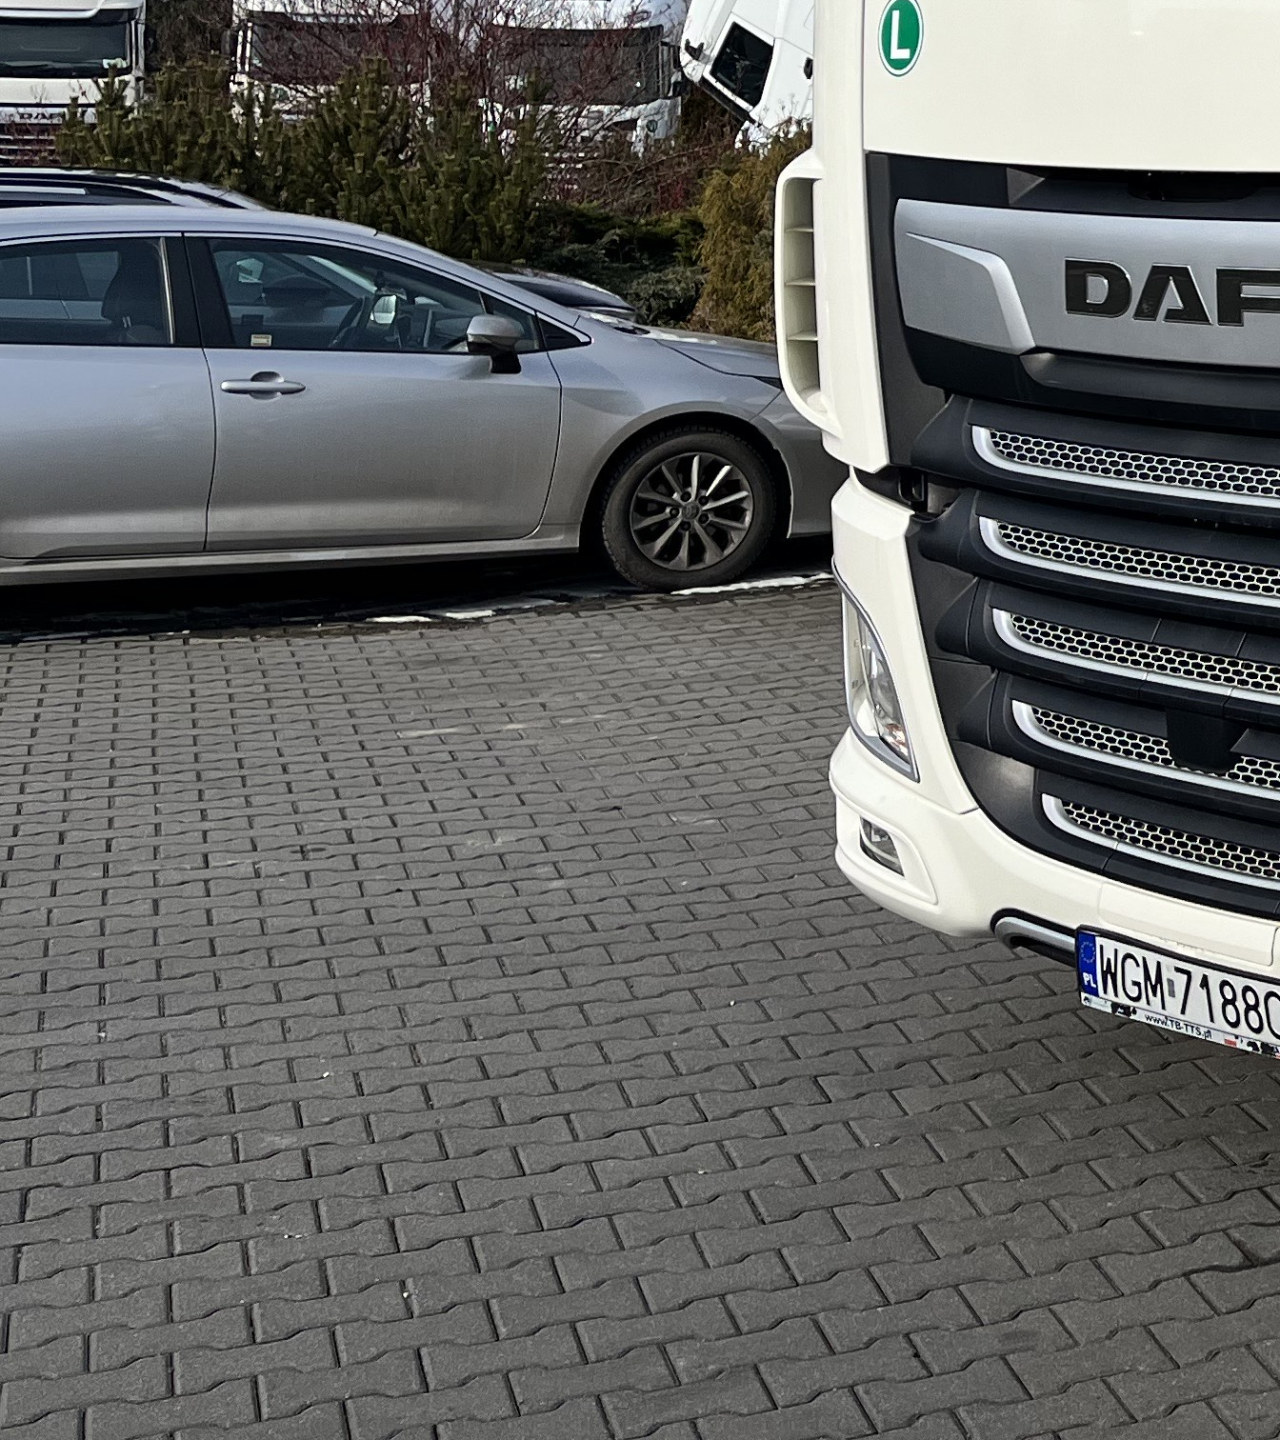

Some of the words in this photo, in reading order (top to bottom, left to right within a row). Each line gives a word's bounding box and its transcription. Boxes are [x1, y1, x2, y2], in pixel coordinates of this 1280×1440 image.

[889, 9, 911, 60] L
[1082, 971, 1097, 989] PL
[1099, 944, 1167, 1011] WGM
